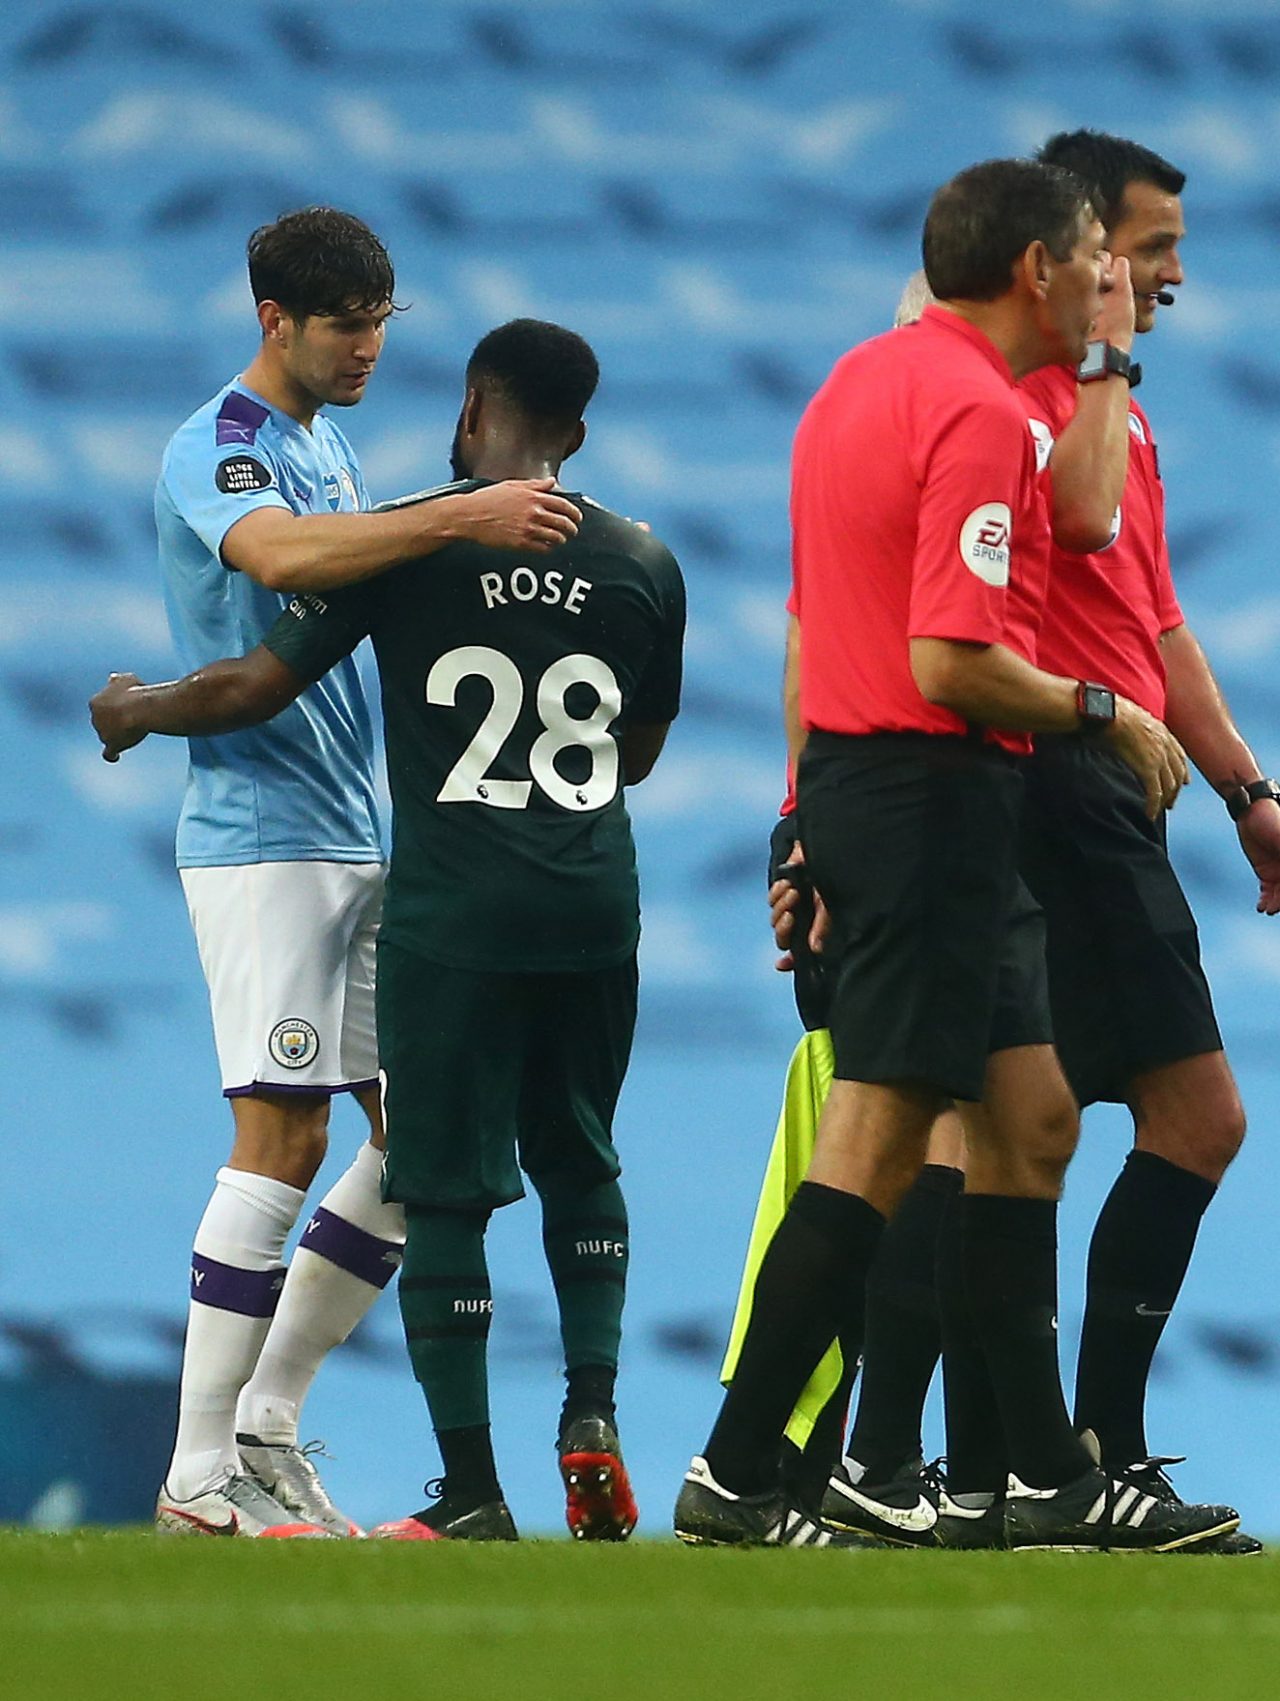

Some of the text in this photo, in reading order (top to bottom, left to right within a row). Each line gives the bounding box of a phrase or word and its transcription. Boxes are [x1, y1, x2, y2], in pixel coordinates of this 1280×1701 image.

[226, 480, 260, 489] MATTER
[229, 472, 254, 482] LIVES
[479, 566, 593, 615] ROSE
[426, 645, 622, 813] 28
